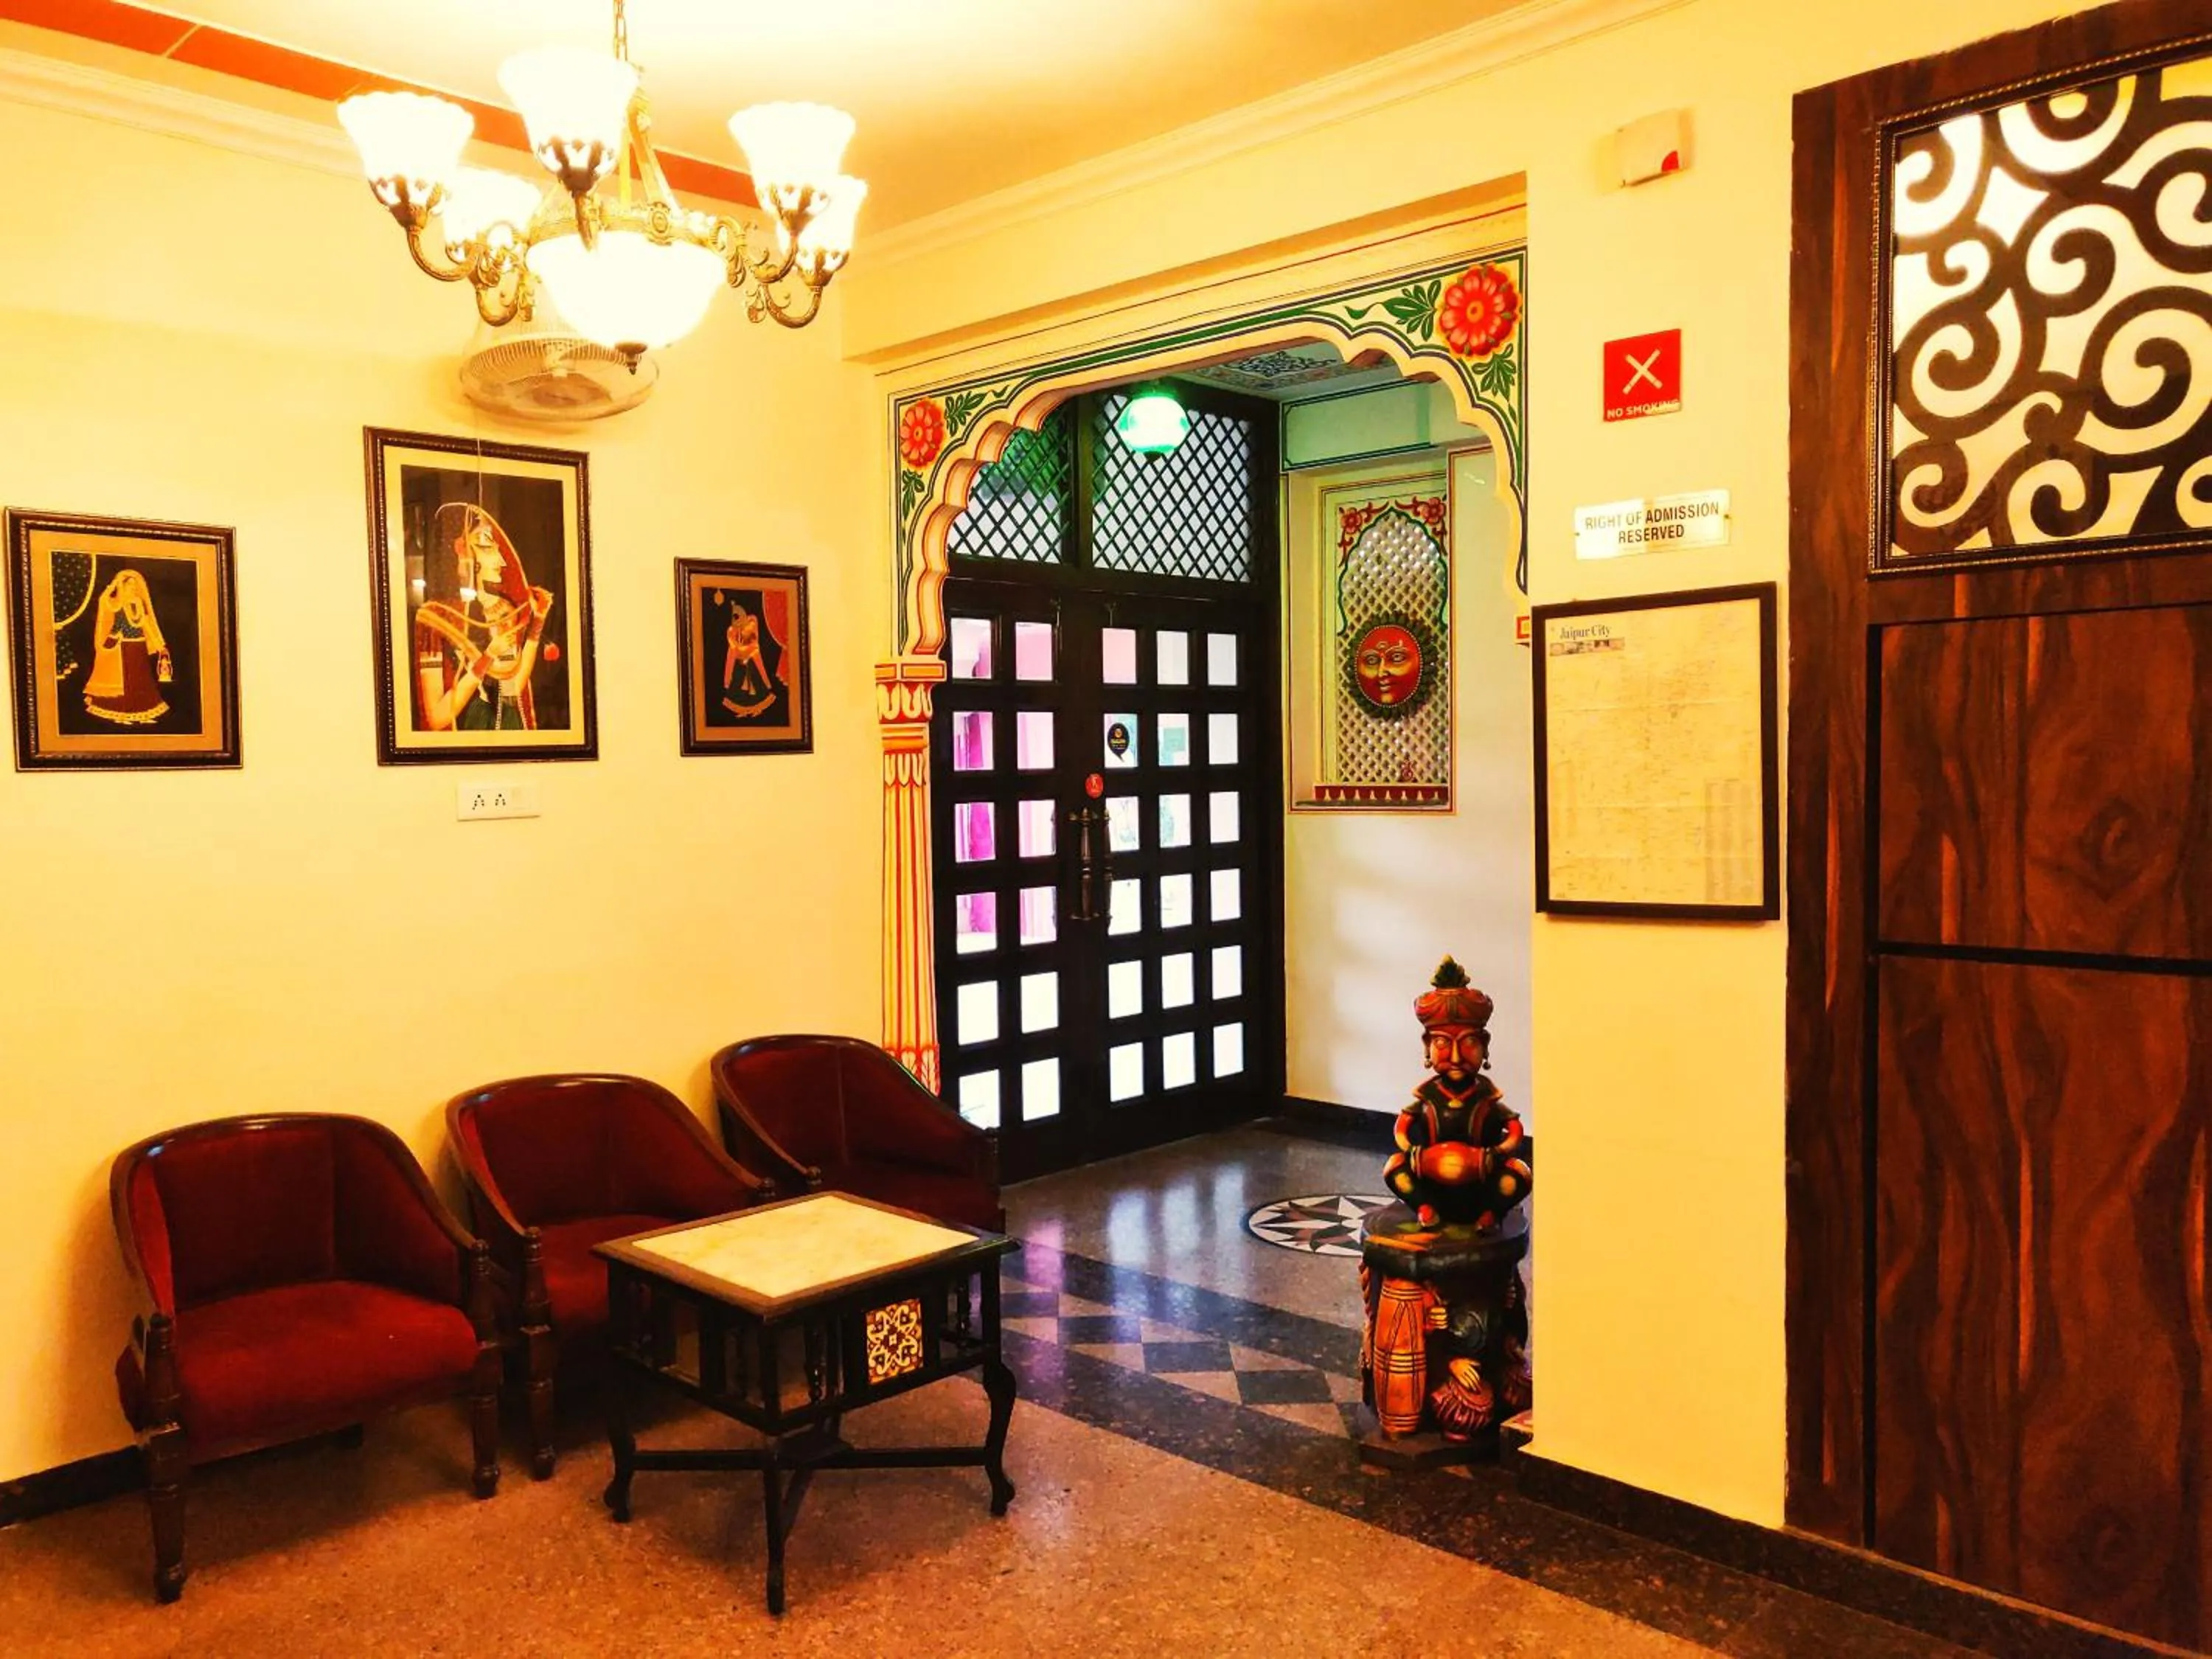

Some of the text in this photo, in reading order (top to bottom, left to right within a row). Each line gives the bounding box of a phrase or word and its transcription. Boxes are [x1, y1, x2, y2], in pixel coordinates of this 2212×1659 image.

[1607, 408, 1623, 420] NO
[1585, 501, 1719, 530] RIGHT OF ADMISSION
[1618, 524, 1685, 543] RESERVED
[1559, 624, 1611, 641] Jaipur City
